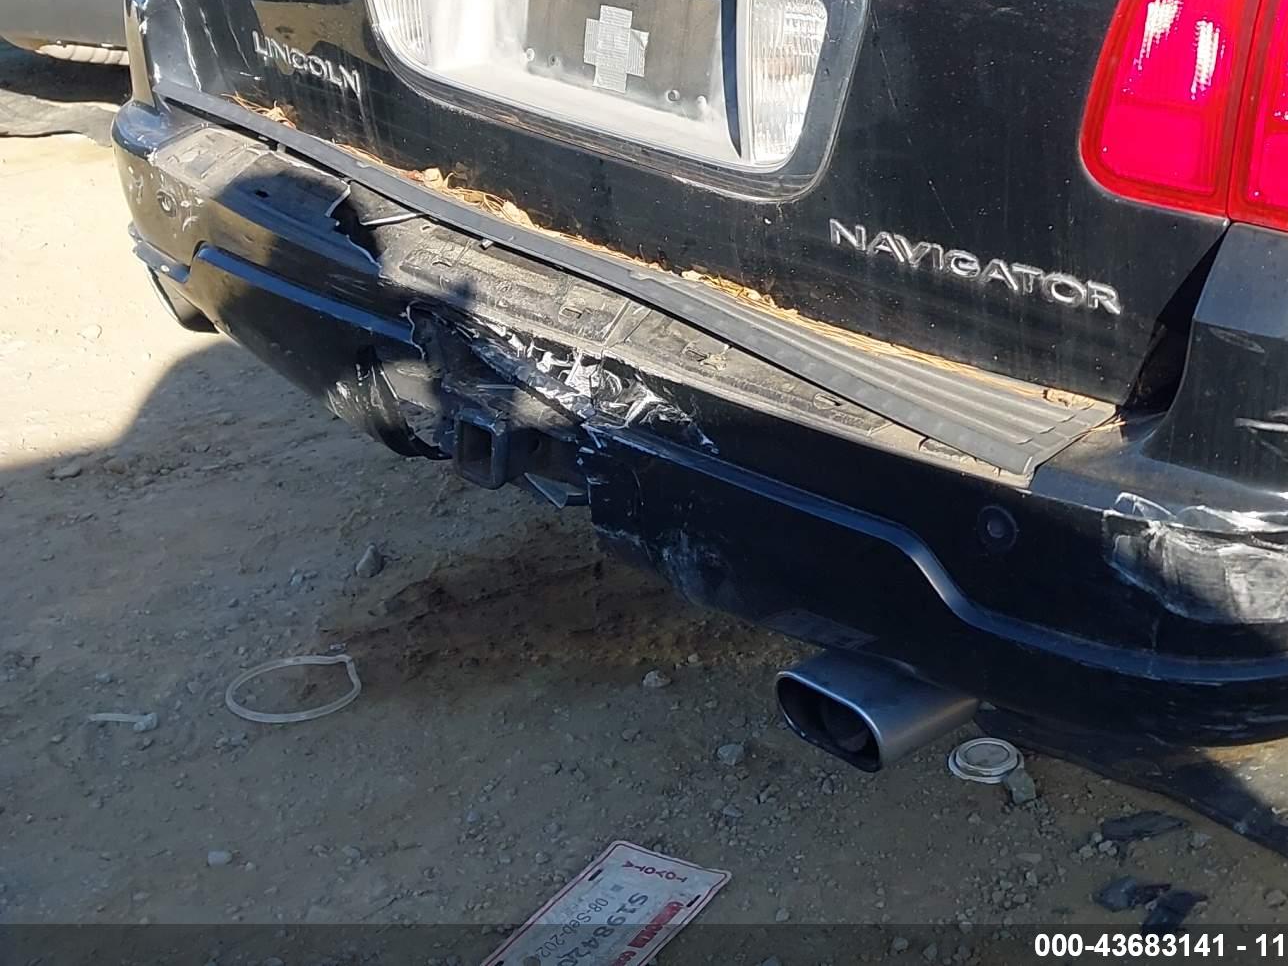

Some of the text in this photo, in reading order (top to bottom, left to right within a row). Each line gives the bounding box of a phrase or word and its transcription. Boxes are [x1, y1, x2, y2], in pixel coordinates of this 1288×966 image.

[252, 30, 362, 97] LINCOLN
[829, 218, 1122, 315] NAVIGATOR
[621, 860, 688, 883] TOYOTA
